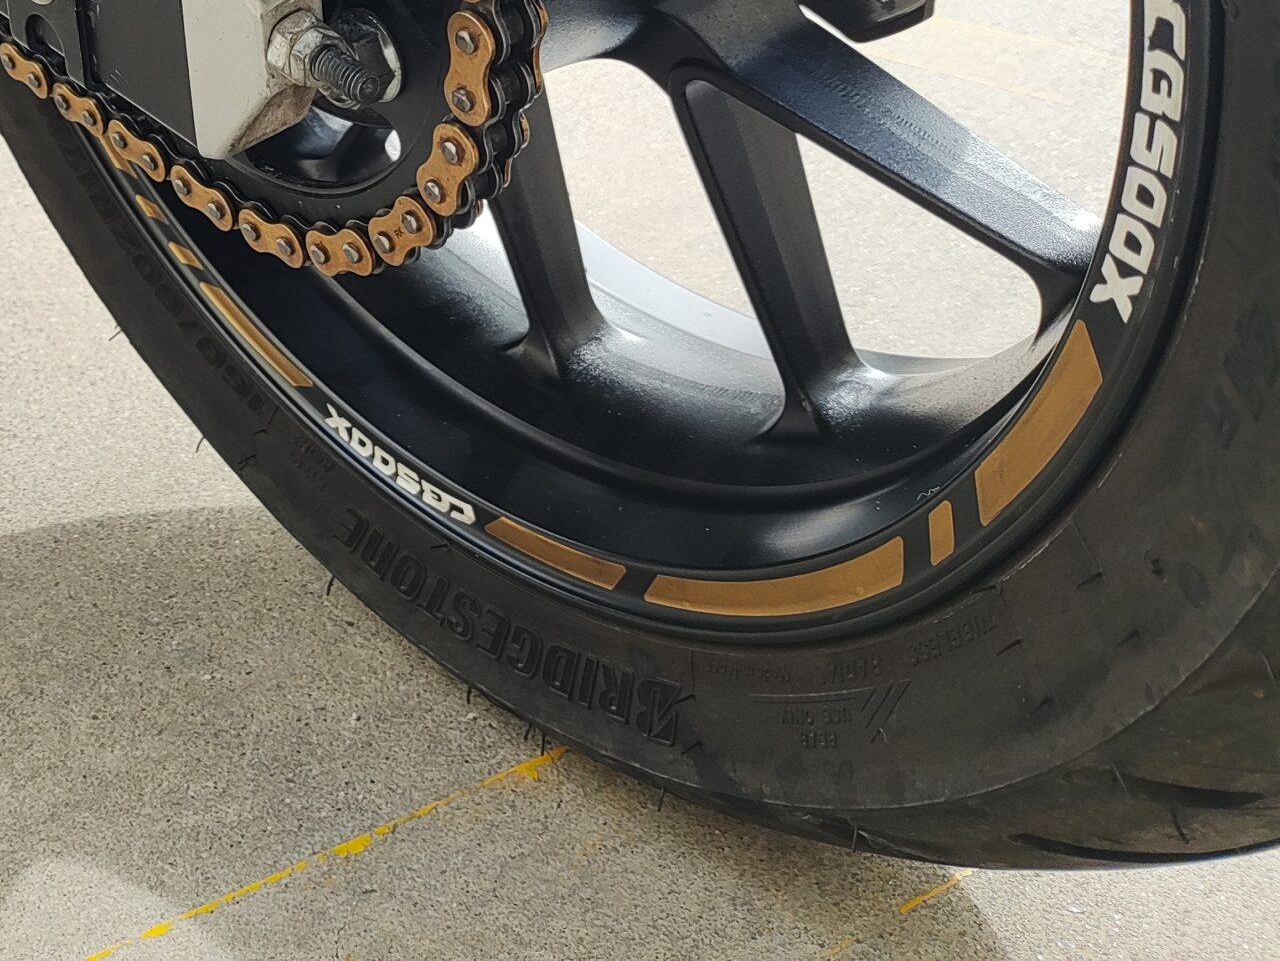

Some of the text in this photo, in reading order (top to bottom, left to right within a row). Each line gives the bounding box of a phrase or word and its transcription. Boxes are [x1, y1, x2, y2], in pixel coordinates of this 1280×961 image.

[325, 403, 477, 525] CB500X
[332, 507, 682, 746] BRIDGESTONE
[781, 706, 853, 726] USE ONLY
